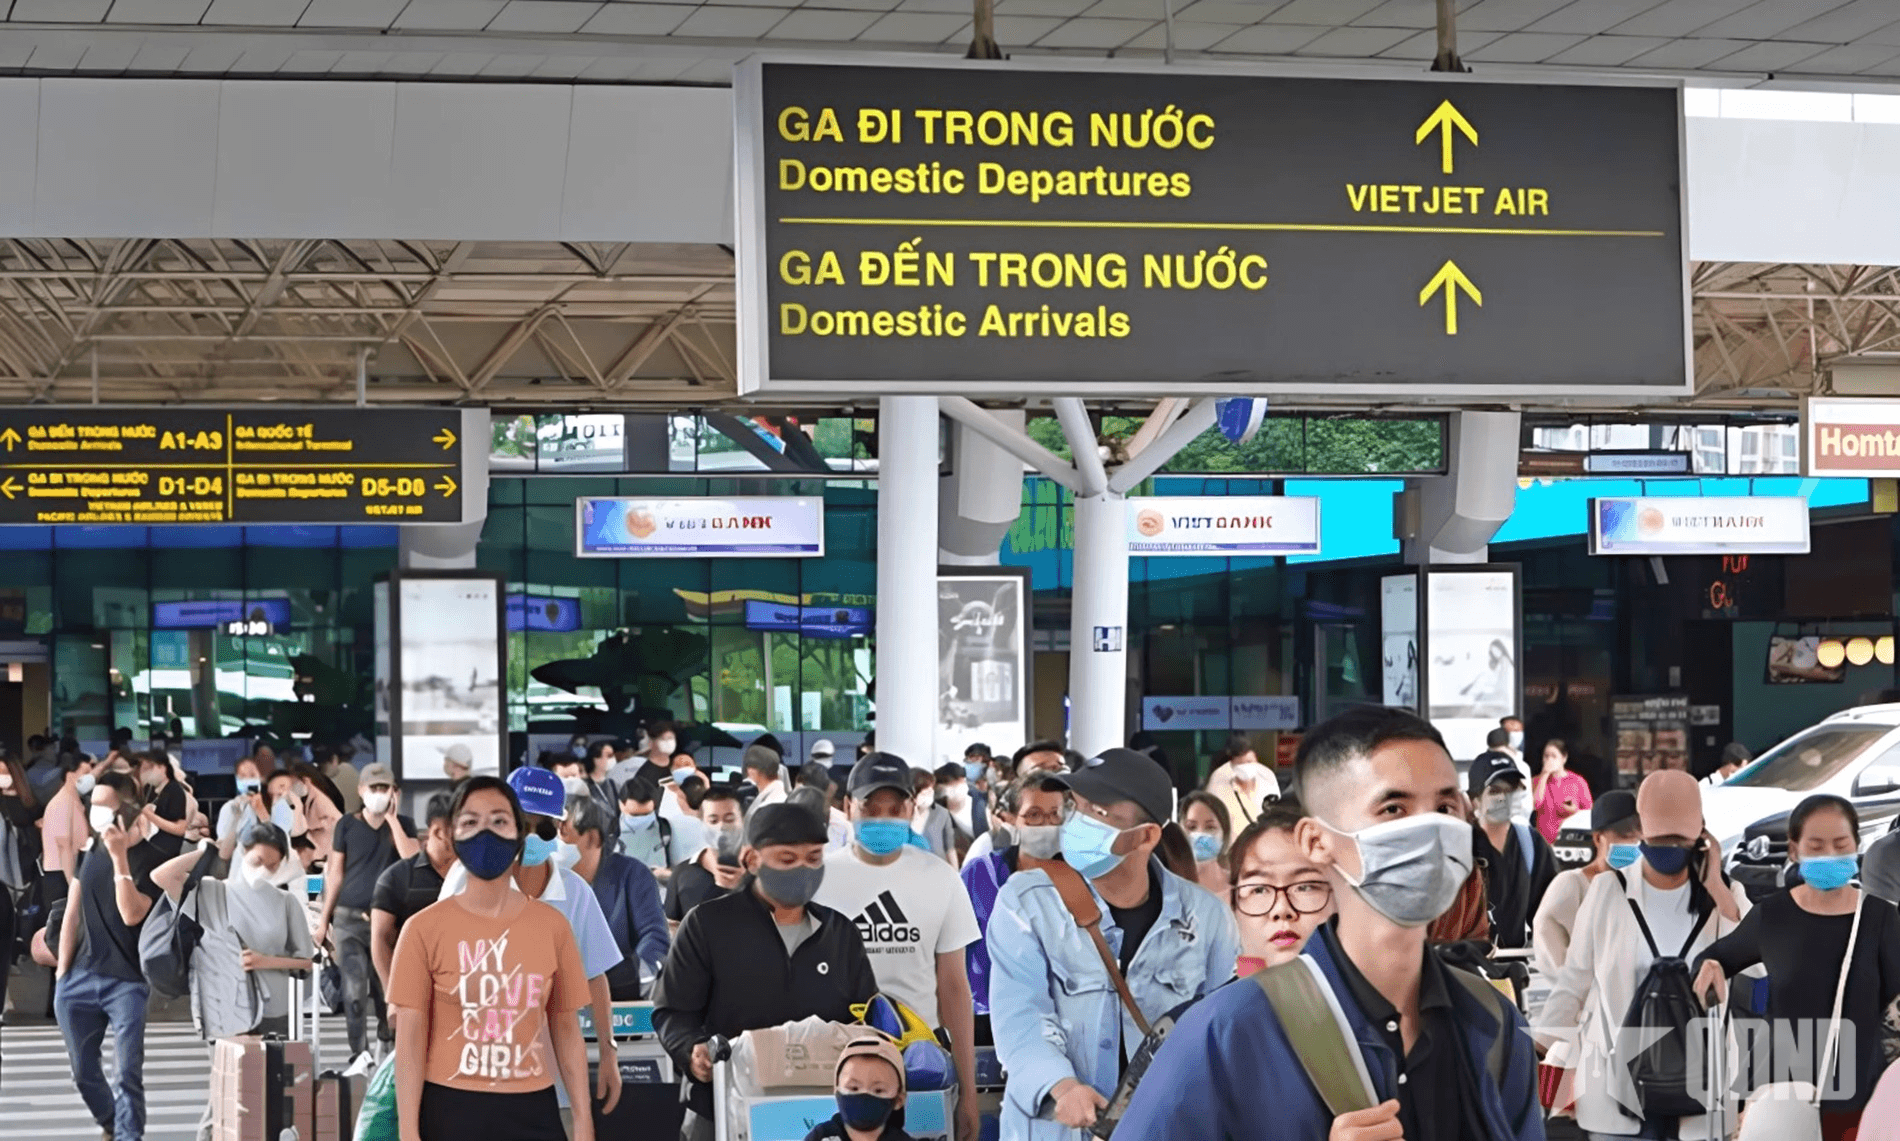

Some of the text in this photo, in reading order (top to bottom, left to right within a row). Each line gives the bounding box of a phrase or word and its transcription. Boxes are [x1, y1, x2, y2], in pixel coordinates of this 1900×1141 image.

[778, 104, 1215, 150] GA ĐI TRONG NƯỚC
[779, 159, 1192, 204] Domestic Departures
[1346, 183, 1549, 216] VIETJET AIR
[779, 236, 1268, 291] GA ĐẾN TRONG NƯỚC
[780, 302, 1131, 338] Domestic Arrivals
[159, 431, 223, 450] A1-A3
[158, 476, 223, 496] D1-D4
[457, 937, 509, 974] MY
[458, 972, 545, 1009] LOVE
[461, 1007, 519, 1045] CAT
[458, 1041, 545, 1079] GIRLS
